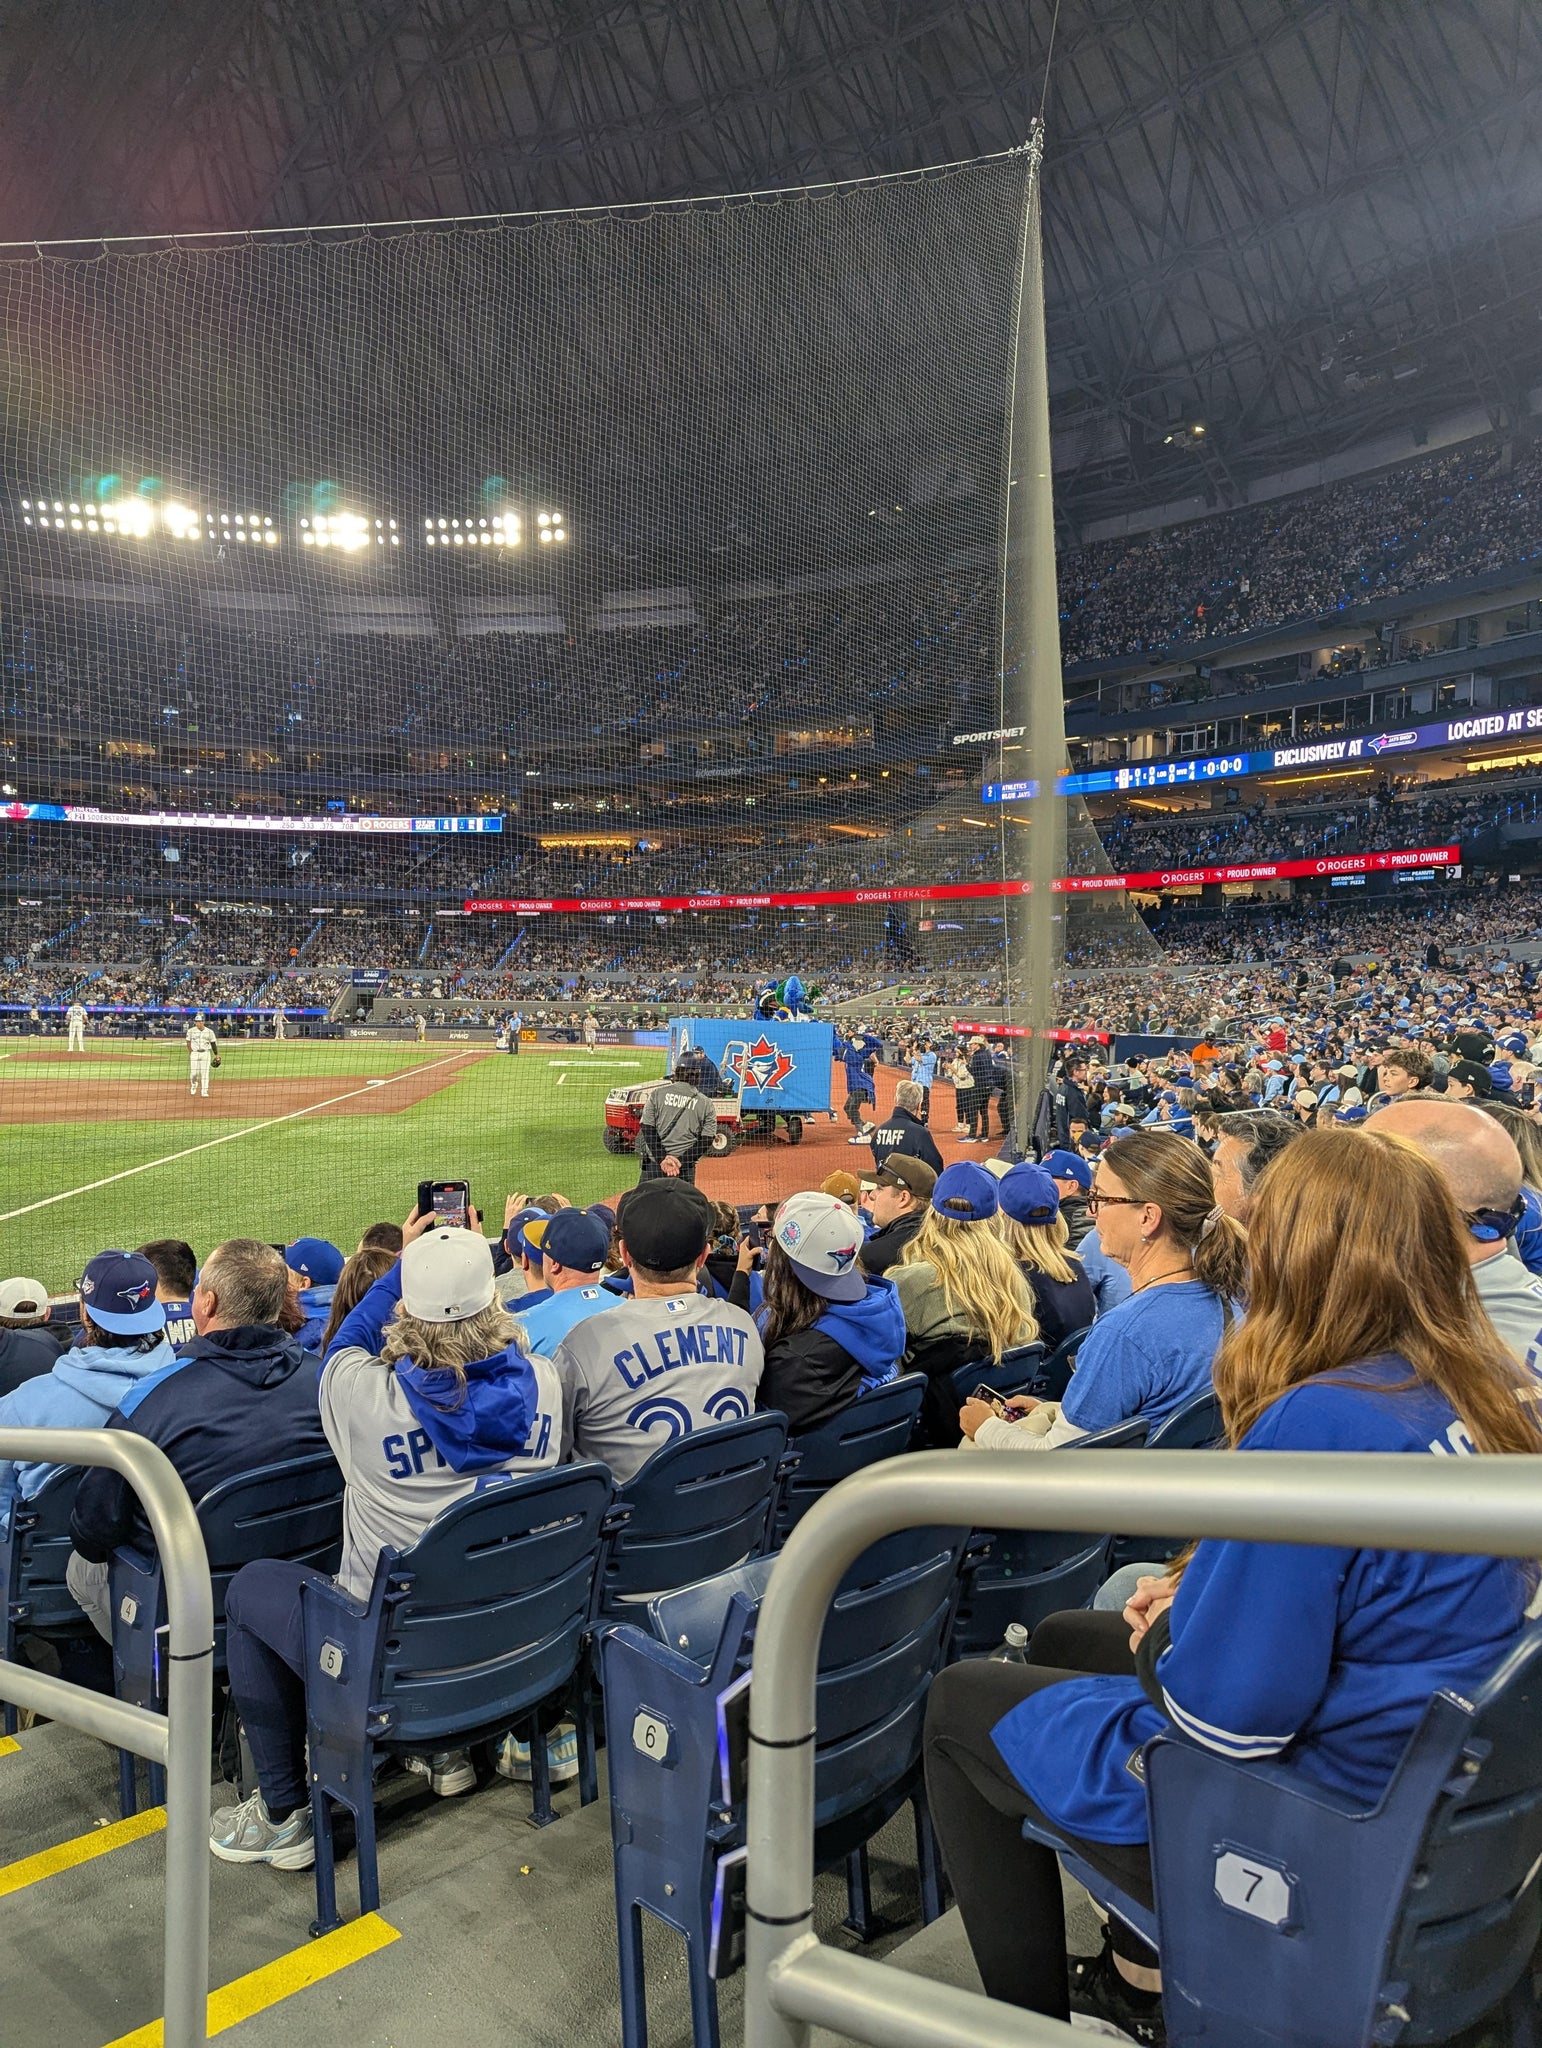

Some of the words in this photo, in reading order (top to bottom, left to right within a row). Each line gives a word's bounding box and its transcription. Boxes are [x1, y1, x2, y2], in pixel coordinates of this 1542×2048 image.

[1448, 716, 1504, 741] LOCATED
[1507, 712, 1524, 732] AT
[953, 727, 1027, 745] SPORTSNET
[1274, 741, 1346, 767] EXCLUSIVELY
[1348, 739, 1363, 757] AT
[1189, 761, 1195, 770] 4
[1207, 762, 1215, 776] 0
[1220, 760, 1228, 773] 0
[1233, 758, 1242, 772] 0
[1189, 771, 1195, 780] 4
[1002, 783, 1027, 791] ATHLETICS
[1017, 791, 1031, 799] JAYS
[374, 820, 409, 829] ROGERS
[1327, 859, 1365, 870] ROGERS
[1392, 854, 1417, 865] PROUD
[1419, 851, 1448, 862] OWNER
[1171, 872, 1204, 881] ROGERS
[1227, 869, 1249, 878] PROUD
[1251, 867, 1276, 876] OWNER
[1448, 867, 1456, 879] 9
[1103, 878, 1126, 886] OWNER
[893, 890, 931, 898] TERRACE
[522, 1031, 536, 1041] 052
[665, 1093, 698, 1111] SECURITY
[876, 1129, 905, 1146] STAFF
[614, 1325, 748, 1389] CLEMENT
[125, 1603, 132, 1617] 4
[327, 1651, 335, 1669] 5
[645, 1725, 656, 1749] 6
[1242, 1868, 1263, 1903] 7
